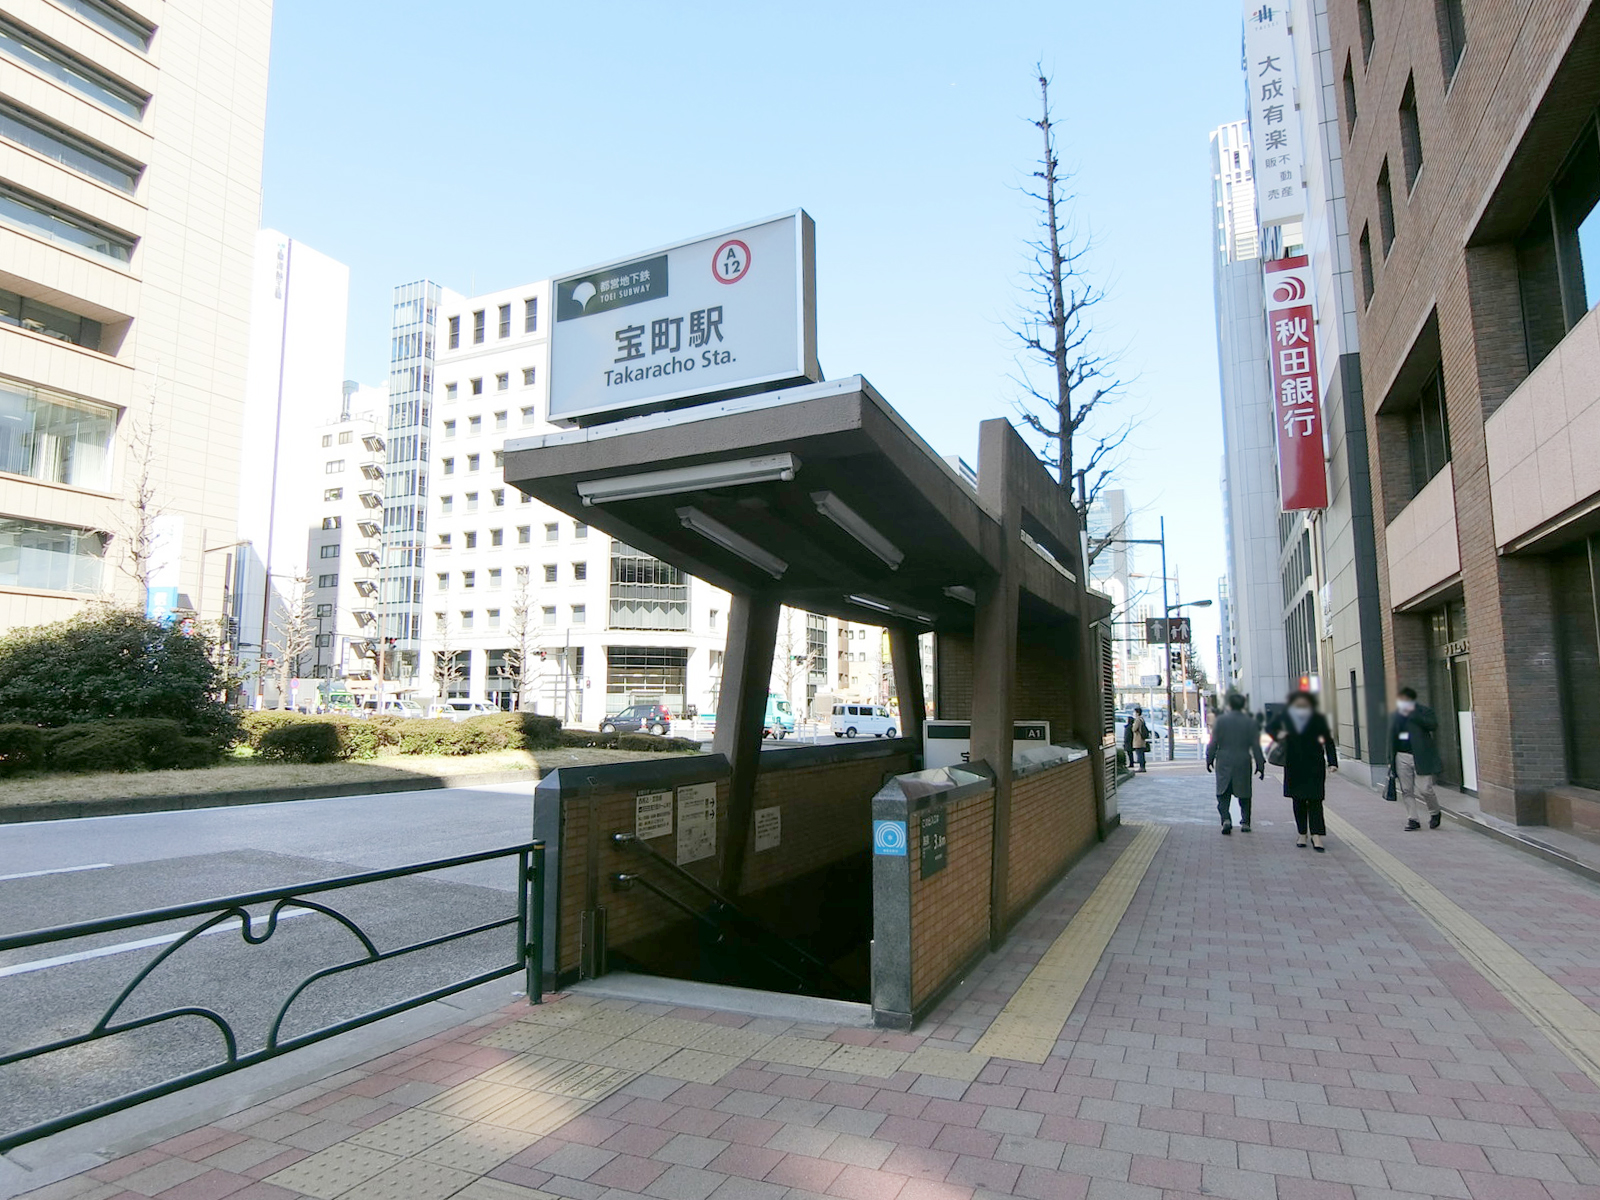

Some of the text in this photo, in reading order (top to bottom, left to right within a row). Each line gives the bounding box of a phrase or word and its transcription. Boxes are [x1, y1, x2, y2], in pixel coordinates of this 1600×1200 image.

[1258, 55, 1288, 151] 大成有楽
[1265, 156, 1280, 201] 販売
[1278, 153, 1294, 198] 不動産
[723, 260, 741, 276] 12
[726, 248, 736, 261] A
[600, 270, 651, 293] 都営地下鉄
[600, 283, 651, 303] TOEI SUBWAY
[614, 306, 723, 363] 宝町駅
[604, 348, 737, 386] Takaracho Sta.
[1275, 317, 1315, 437] 秋田銀行
[1028, 729, 1041, 738] A1
